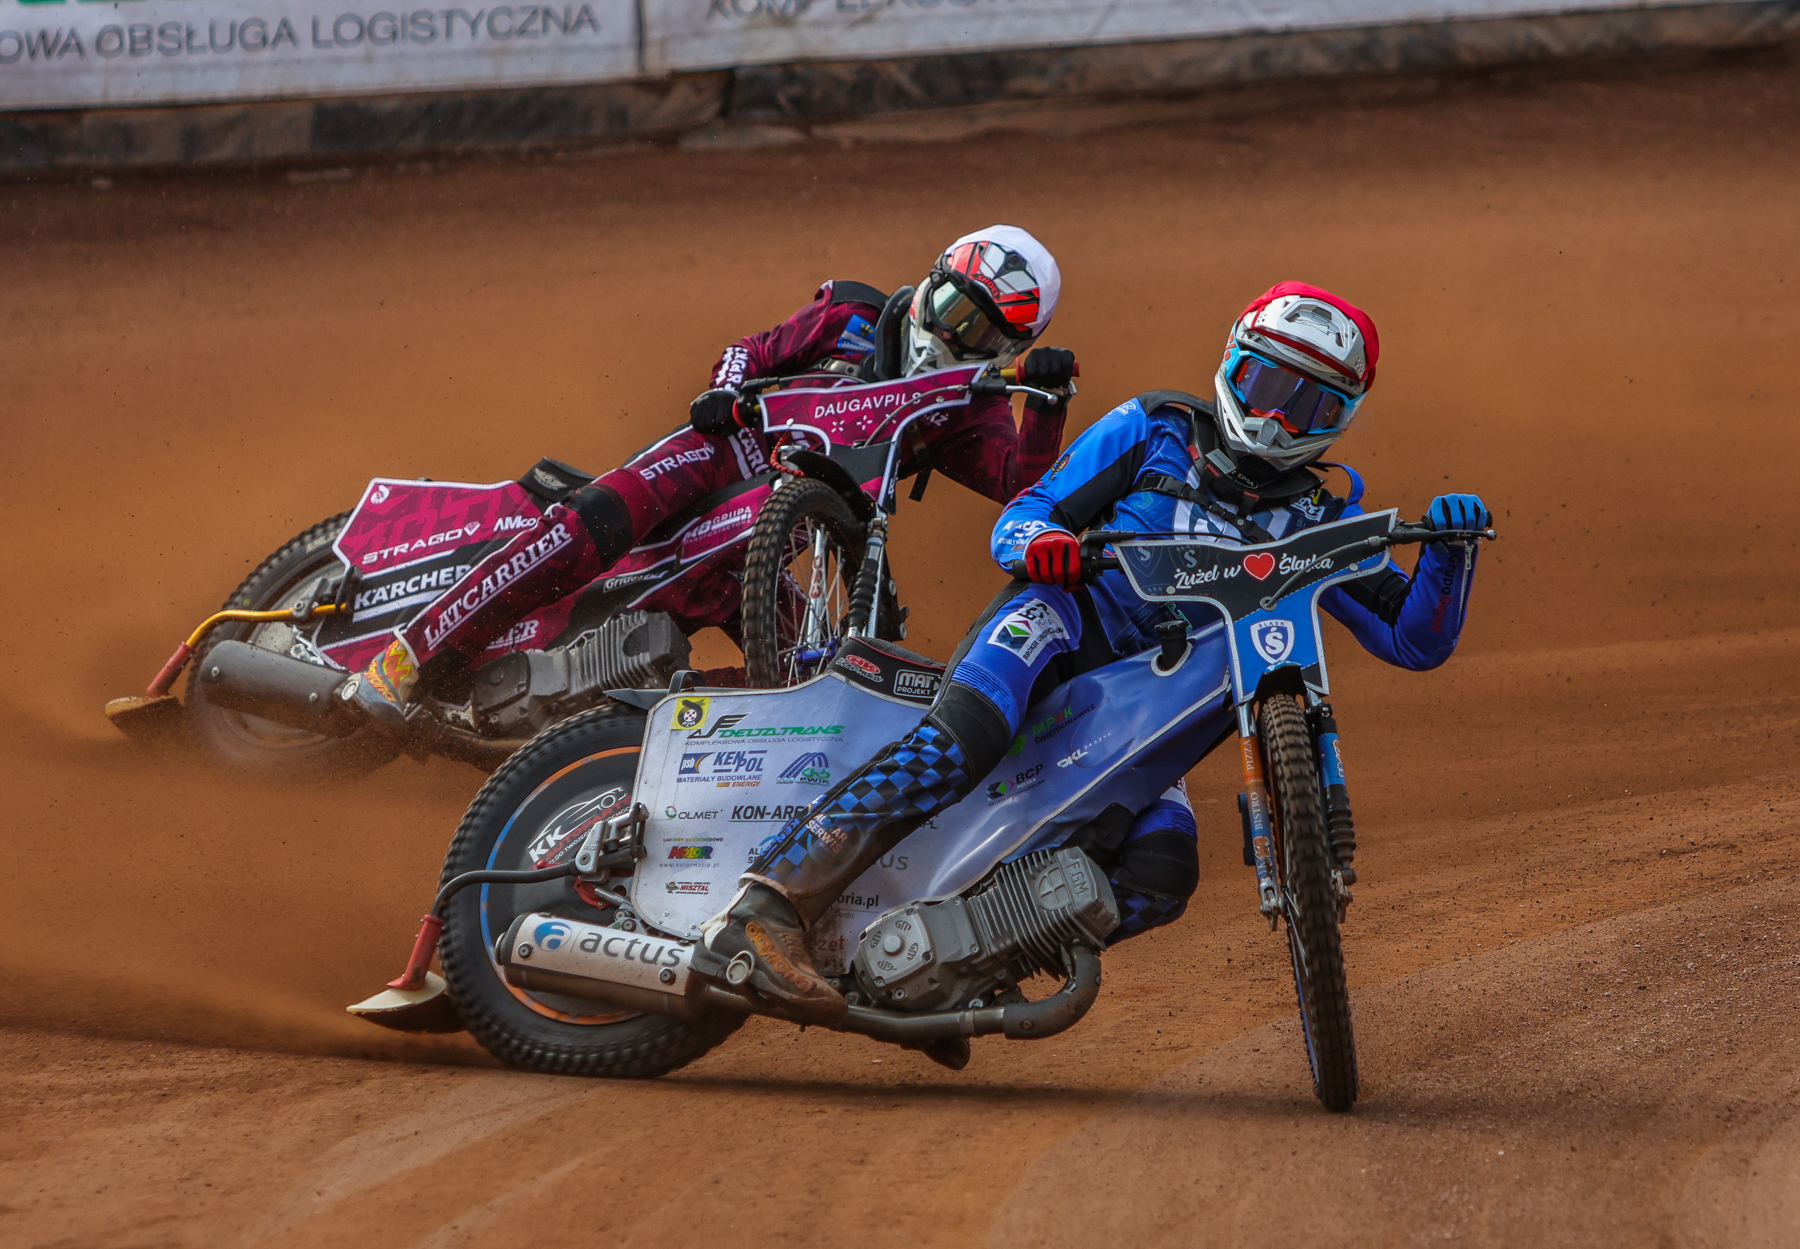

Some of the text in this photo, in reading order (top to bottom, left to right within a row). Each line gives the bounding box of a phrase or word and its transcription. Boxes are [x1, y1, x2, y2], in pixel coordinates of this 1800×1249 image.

[0, 3, 602, 65] OWA OBSŁUGA LOGISTYCZNA
[975, 275, 1000, 297] SHOEI
[1173, 564, 1220, 590] Żużel
[1222, 563, 1242, 579] w
[423, 522, 572, 648] LATCARRIER
[1023, 640, 1040, 661] BROKER
[898, 672, 935, 689] MAT
[896, 686, 932, 696] PROJEKT
[681, 720, 696, 728] PZM
[1032, 705, 1074, 737] MPUK
[684, 738, 746, 747] KOMPLEKSOWA
[712, 751, 746, 767] KEN
[1243, 738, 1255, 771] PIZZA
[680, 756, 695, 771] psb
[733, 757, 764, 773] POL
[675, 774, 763, 784] MATERIAŁY BUDOWLANE
[1016, 763, 1044, 784] BCP
[731, 780, 762, 788] ENERGY
[677, 810, 719, 820] OLMET
[1250, 791, 1263, 831] BISTRO
[805, 820, 843, 854] SERWIS
[555, 852, 565, 861] DO
[667, 845, 714, 860] KOLOR
[679, 884, 710, 892] MISZTAL
[578, 930, 686, 968] actus
